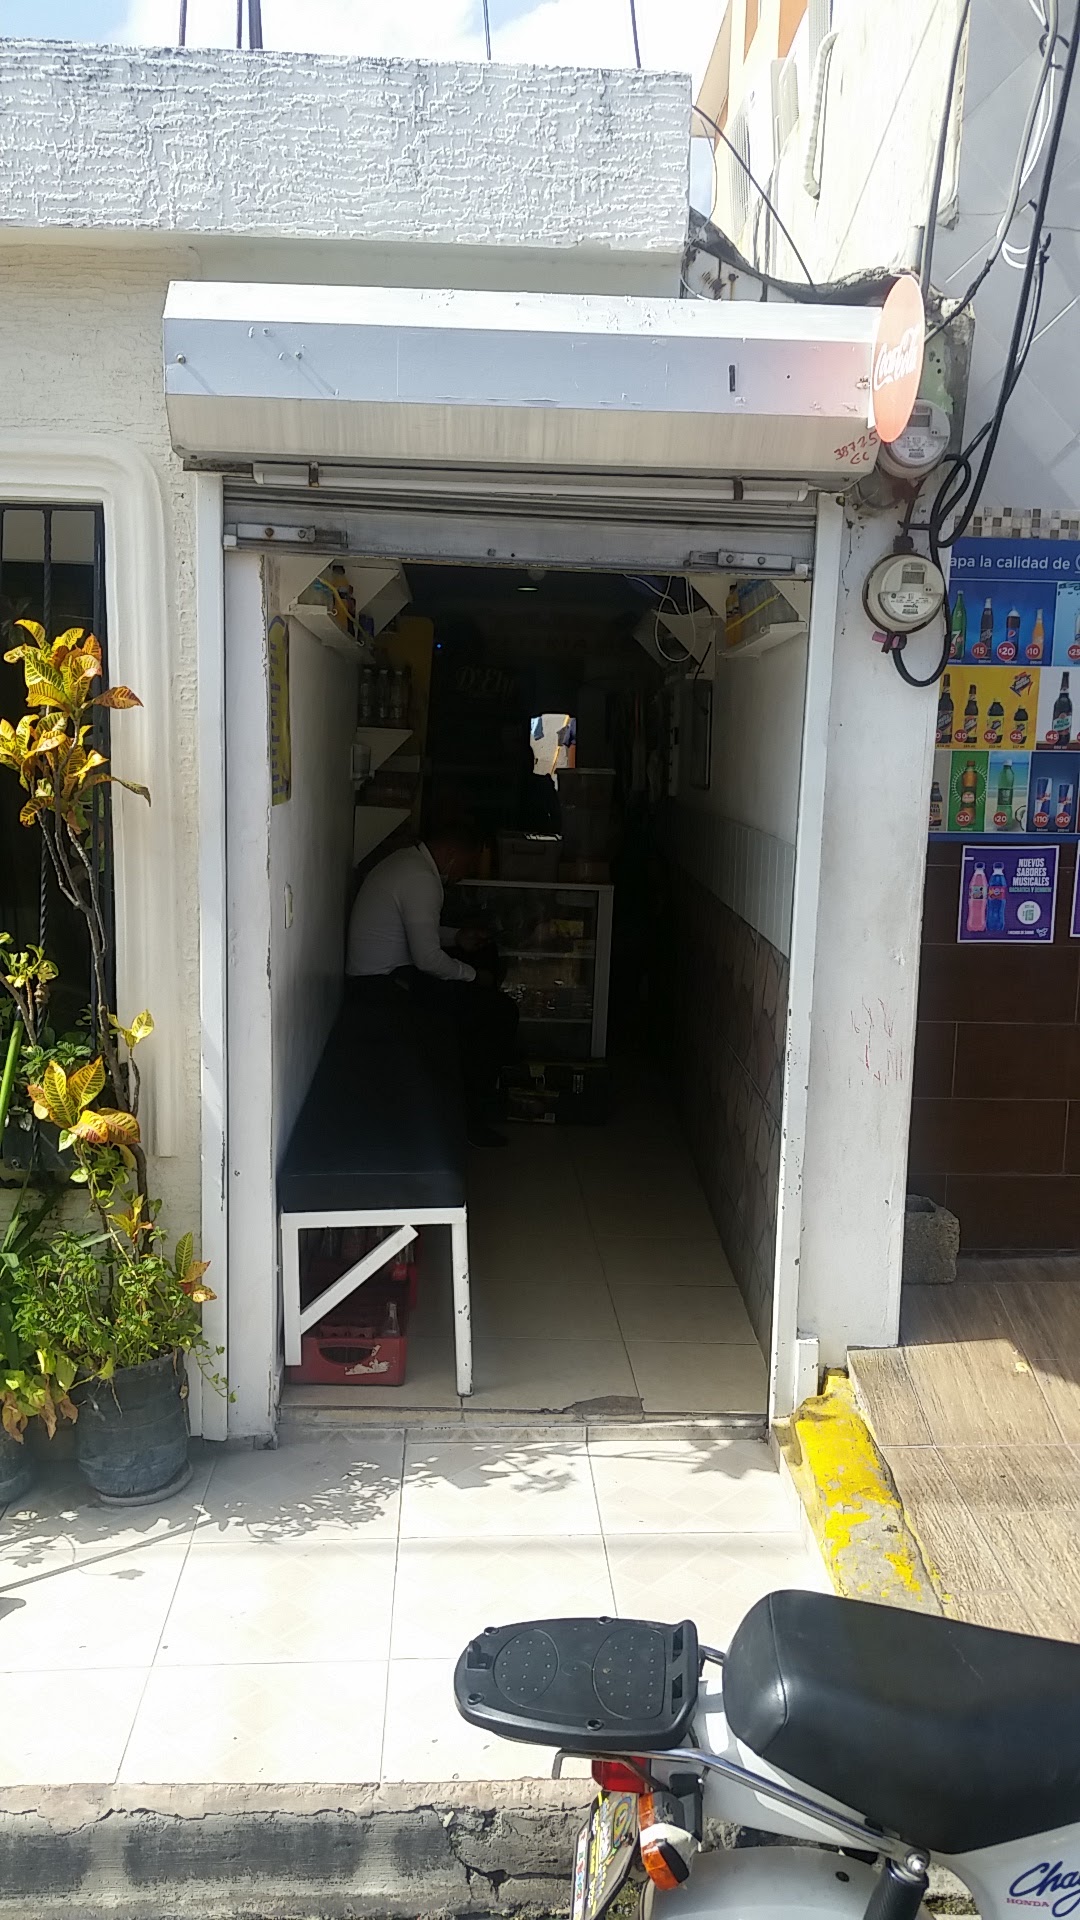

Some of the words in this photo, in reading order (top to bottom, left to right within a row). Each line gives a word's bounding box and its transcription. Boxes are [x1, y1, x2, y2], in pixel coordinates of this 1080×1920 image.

[833, 429, 878, 461] 38725
[980, 555, 992, 568] la
[996, 554, 1049, 570] calidad
[1052, 557, 1071, 570] de
[998, 646, 1014, 656] $20
[1018, 857, 1045, 868] NUEVOS
[1016, 867, 1047, 877] SABORES
[1012, 876, 1050, 887] MUSICALES
[1006, 1897, 1050, 1908] HONDA
